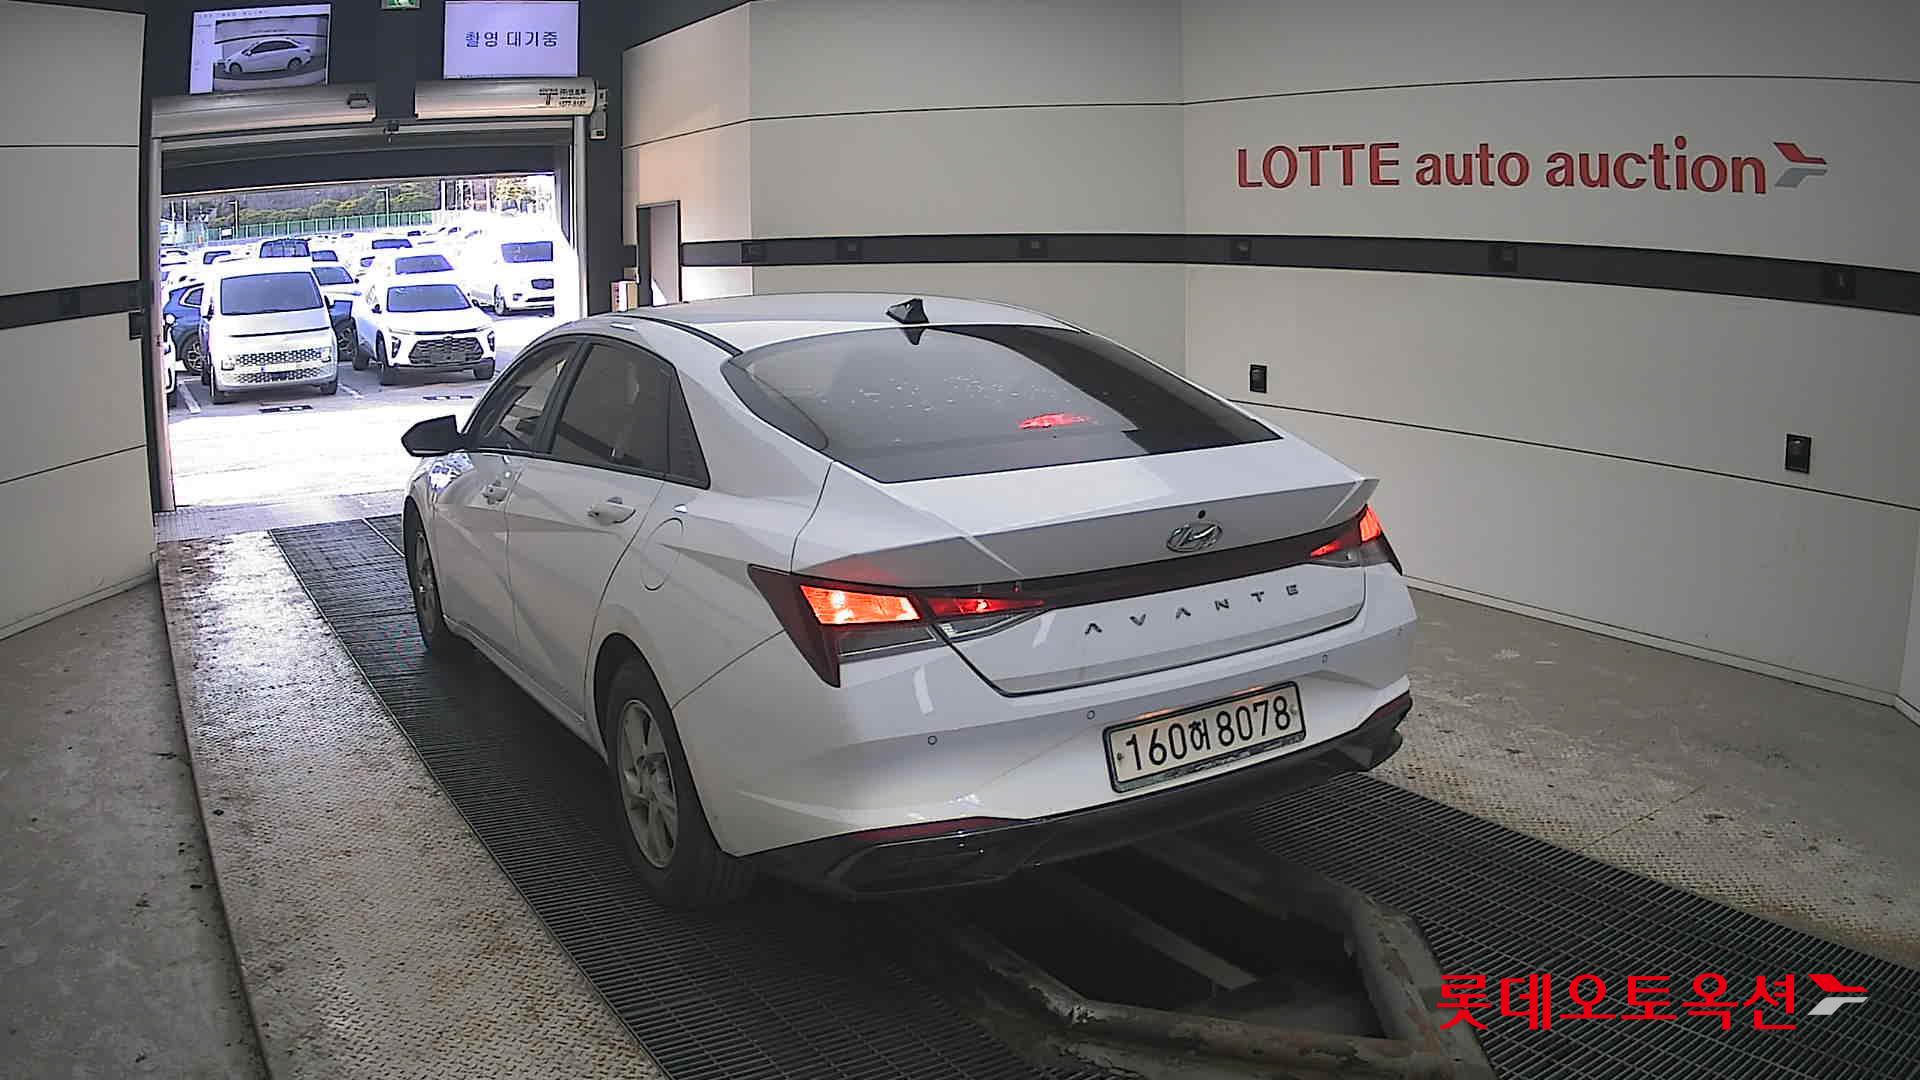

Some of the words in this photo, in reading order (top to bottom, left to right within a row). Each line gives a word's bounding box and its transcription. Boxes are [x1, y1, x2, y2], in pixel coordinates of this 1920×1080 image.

[506, 31, 558, 48] 대기중
[1237, 142, 1400, 189] LOTTE
[1415, 143, 1530, 187] auto
[1546, 135, 1768, 194] auction
[1084, 583, 1299, 636] AVANTE
